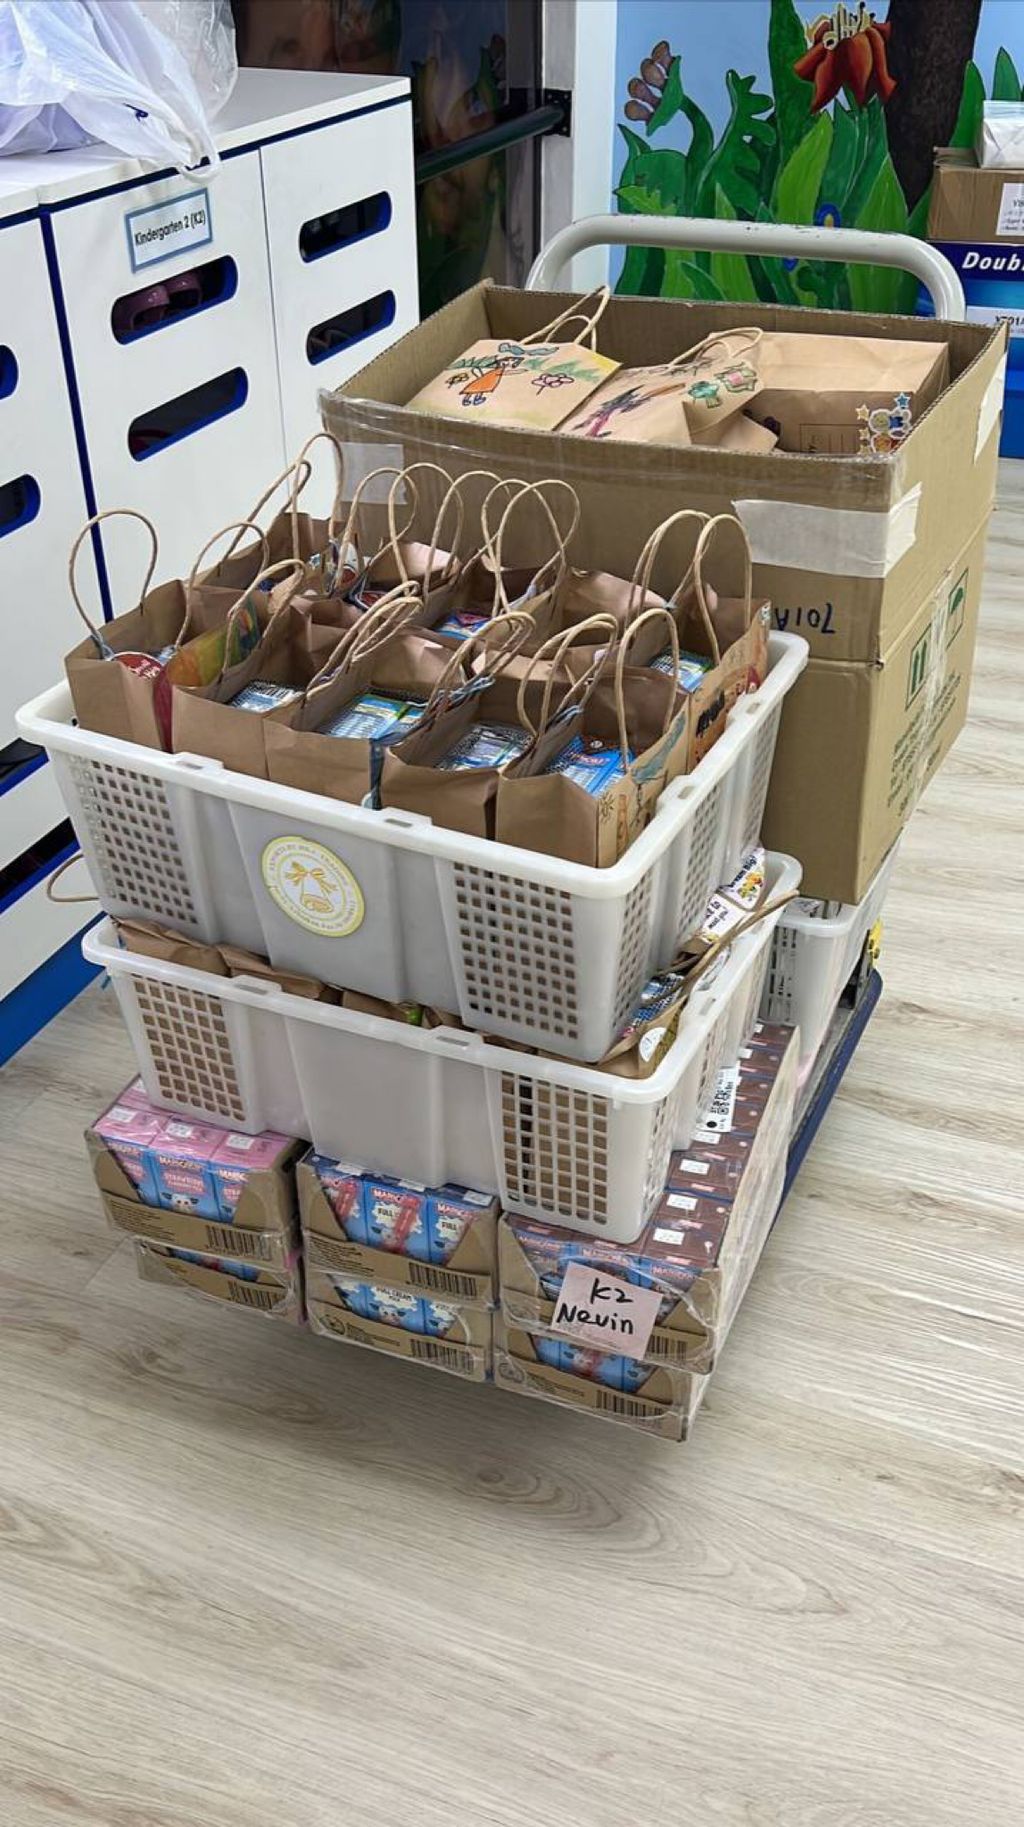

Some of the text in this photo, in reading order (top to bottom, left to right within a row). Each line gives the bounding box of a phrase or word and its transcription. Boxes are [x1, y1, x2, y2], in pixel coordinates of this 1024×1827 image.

[135, 209, 206, 246] Kindergarten 2 (K2)
[961, 251, 1024, 271] Doub
[590, 1277, 634, 1305] K2
[555, 1302, 634, 1336] Nevin
